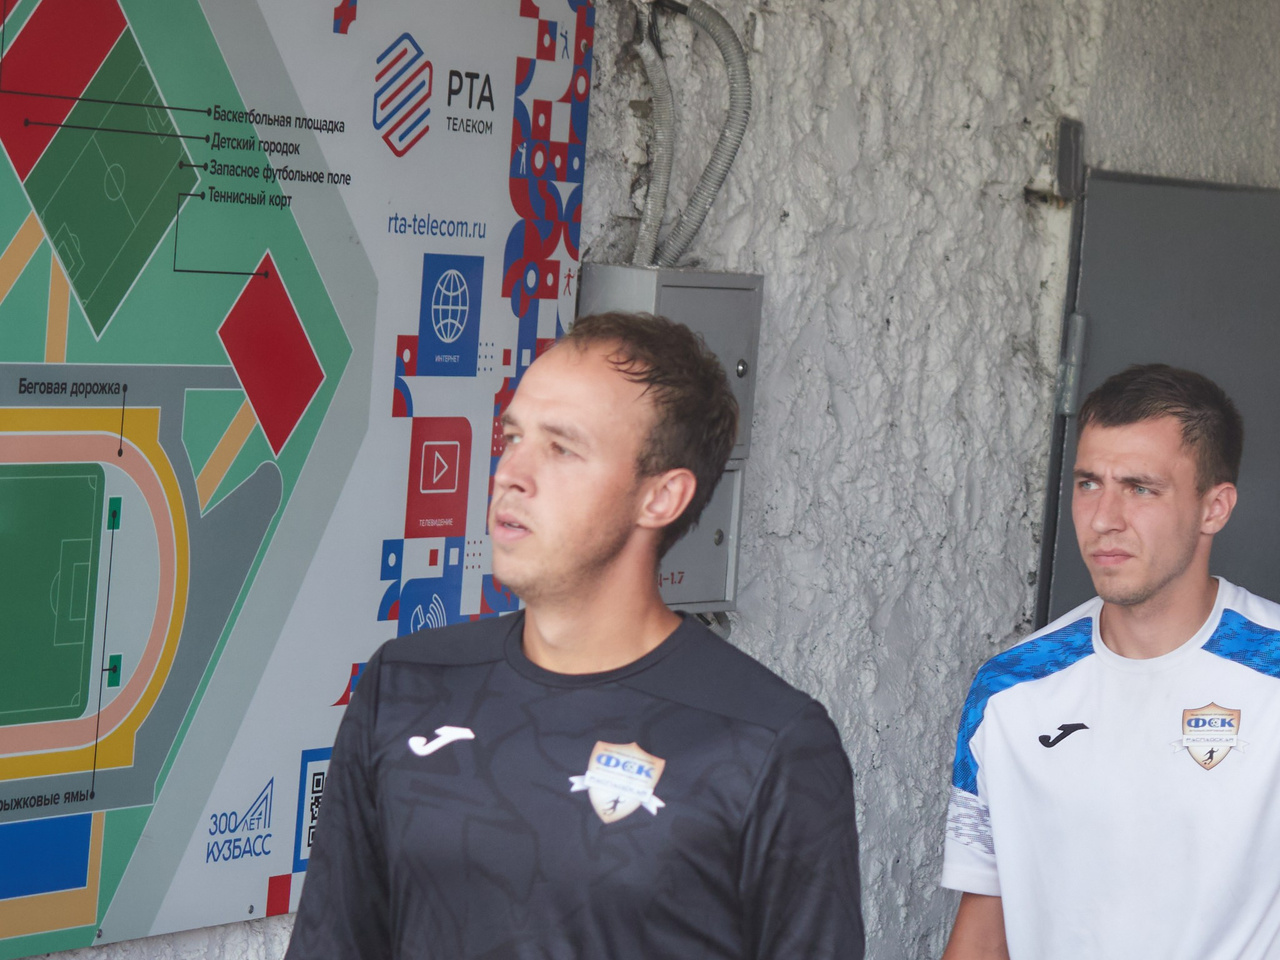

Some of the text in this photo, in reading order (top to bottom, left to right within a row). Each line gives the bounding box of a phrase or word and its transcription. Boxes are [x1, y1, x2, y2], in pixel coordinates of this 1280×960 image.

[448, 70, 494, 111] РТА
[213, 105, 345, 134] Баскетбольная площадка
[447, 116, 493, 135] ТЕЛЕКОМ
[211, 132, 300, 156] Детский городок
[210, 159, 351, 185] Запасное футбольное поле
[208, 186, 292, 210] Теннисный корт
[388, 213, 486, 239] rta-telecom.ru
[435, 355, 460, 363] ИНТЕРНЕТ
[19, 377, 120, 398] Беговая дорожка
[419, 518, 453, 527] ТЕЛЕВИДЕНИЕ
[1187, 717, 1236, 728] ФСК
[64, 789, 89, 804] ямы
[209, 811, 262, 836] 300 ЛЕТ
[206, 833, 272, 863] КУЗБАСС
